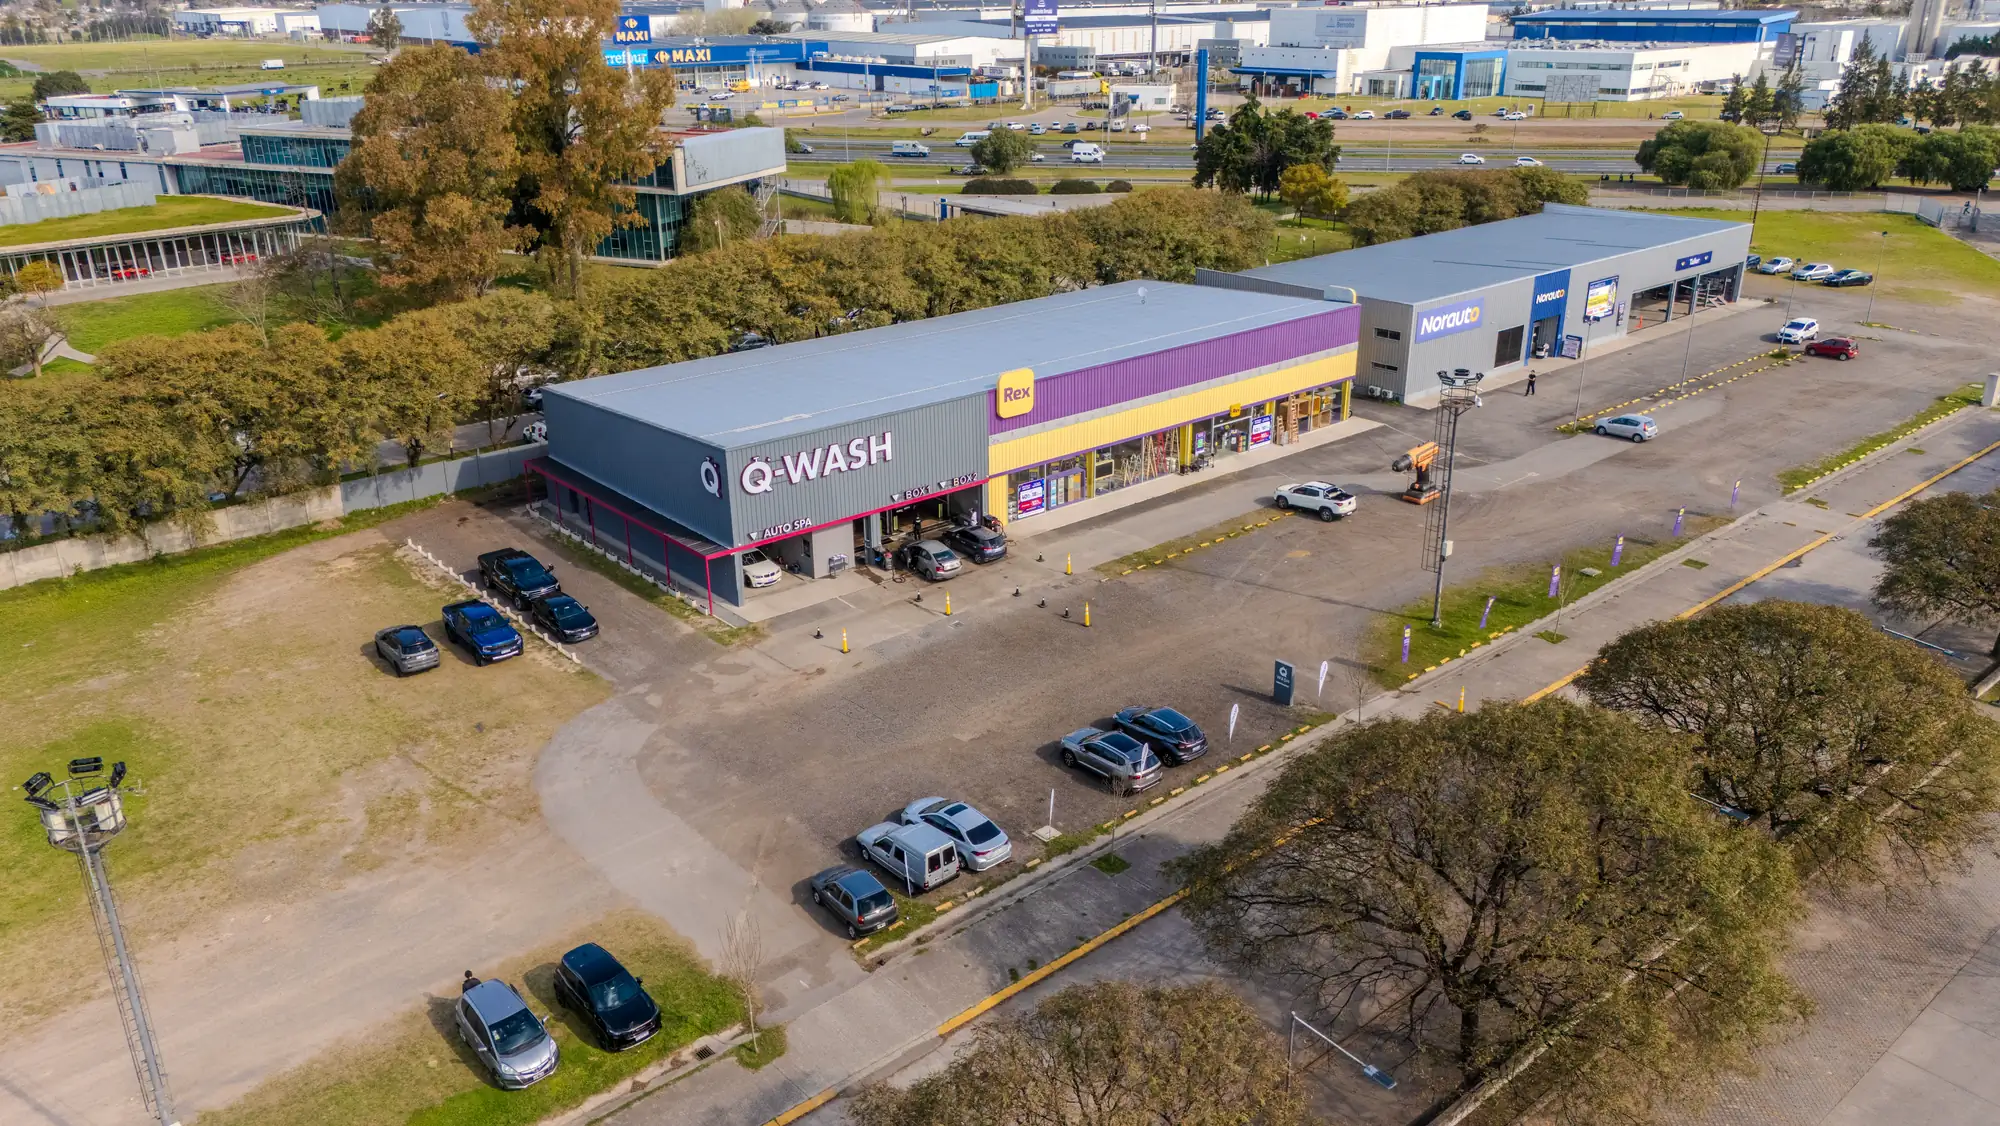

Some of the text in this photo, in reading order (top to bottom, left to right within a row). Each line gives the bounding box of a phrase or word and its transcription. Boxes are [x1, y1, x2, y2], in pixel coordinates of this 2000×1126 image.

[616, 31, 649, 42] MAXI
[604, 48, 711, 65] rrefur MAXI
[1535, 288, 1565, 304] Norauto
[1420, 306, 1480, 335] Norauto
[1004, 387, 1030, 403] Rex
[741, 431, 892, 495] Q-WASH
[763, 517, 813, 539] AUTO SPA
